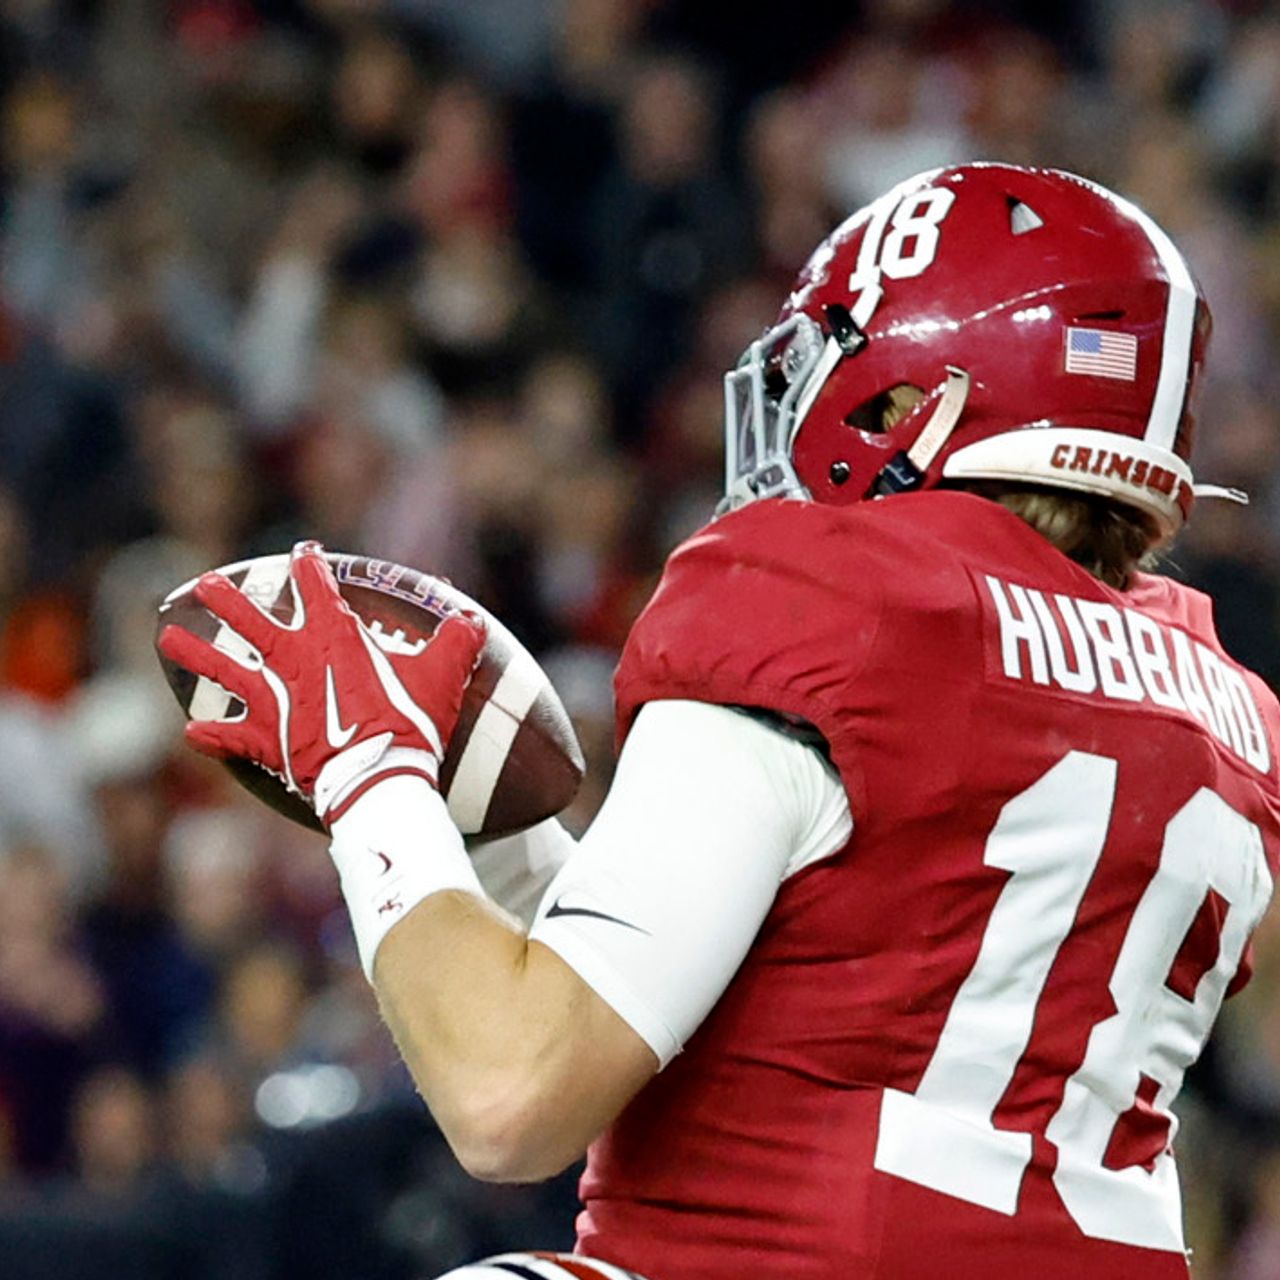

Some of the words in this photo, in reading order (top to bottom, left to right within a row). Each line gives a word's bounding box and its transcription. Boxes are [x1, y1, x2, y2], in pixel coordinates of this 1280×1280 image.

[849, 187, 956, 294] 18
[984, 575, 1273, 774] HUBBARD
[874, 751, 1275, 1253] 18
